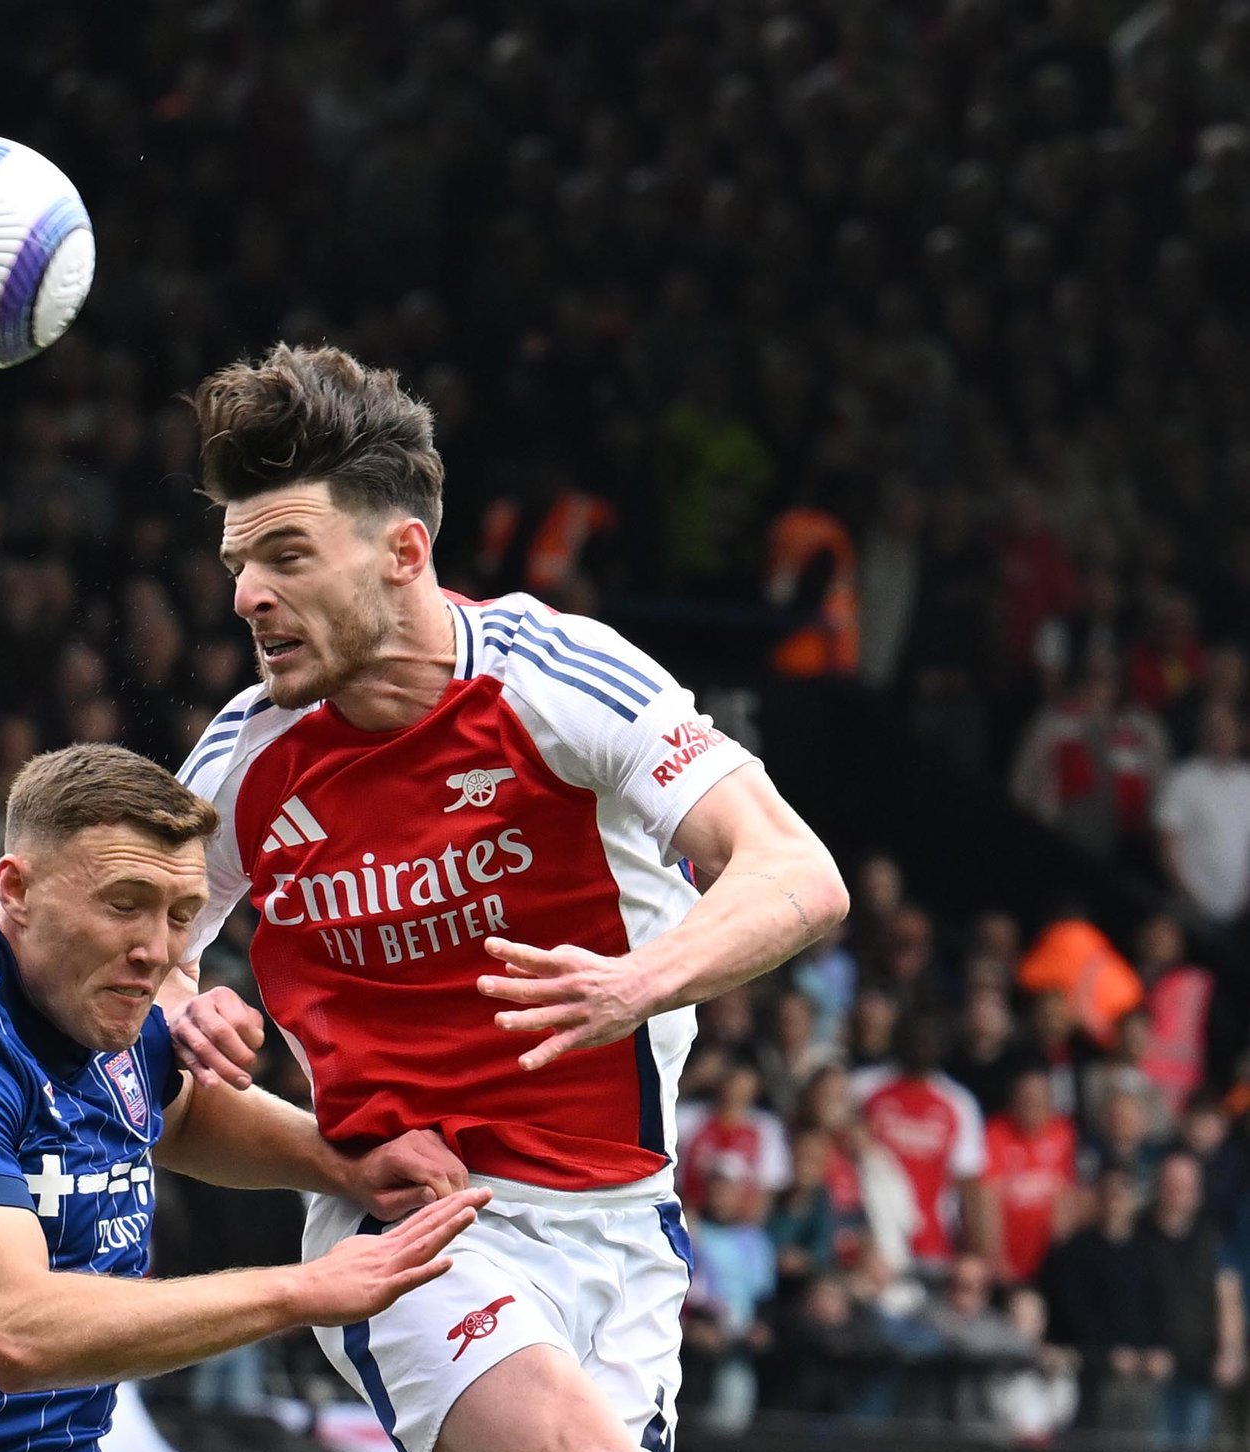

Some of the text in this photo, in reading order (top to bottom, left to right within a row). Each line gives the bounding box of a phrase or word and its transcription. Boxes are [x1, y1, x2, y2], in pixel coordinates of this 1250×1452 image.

[264, 828, 533, 926] Emirates
[319, 894, 510, 966] FLY BETTER
